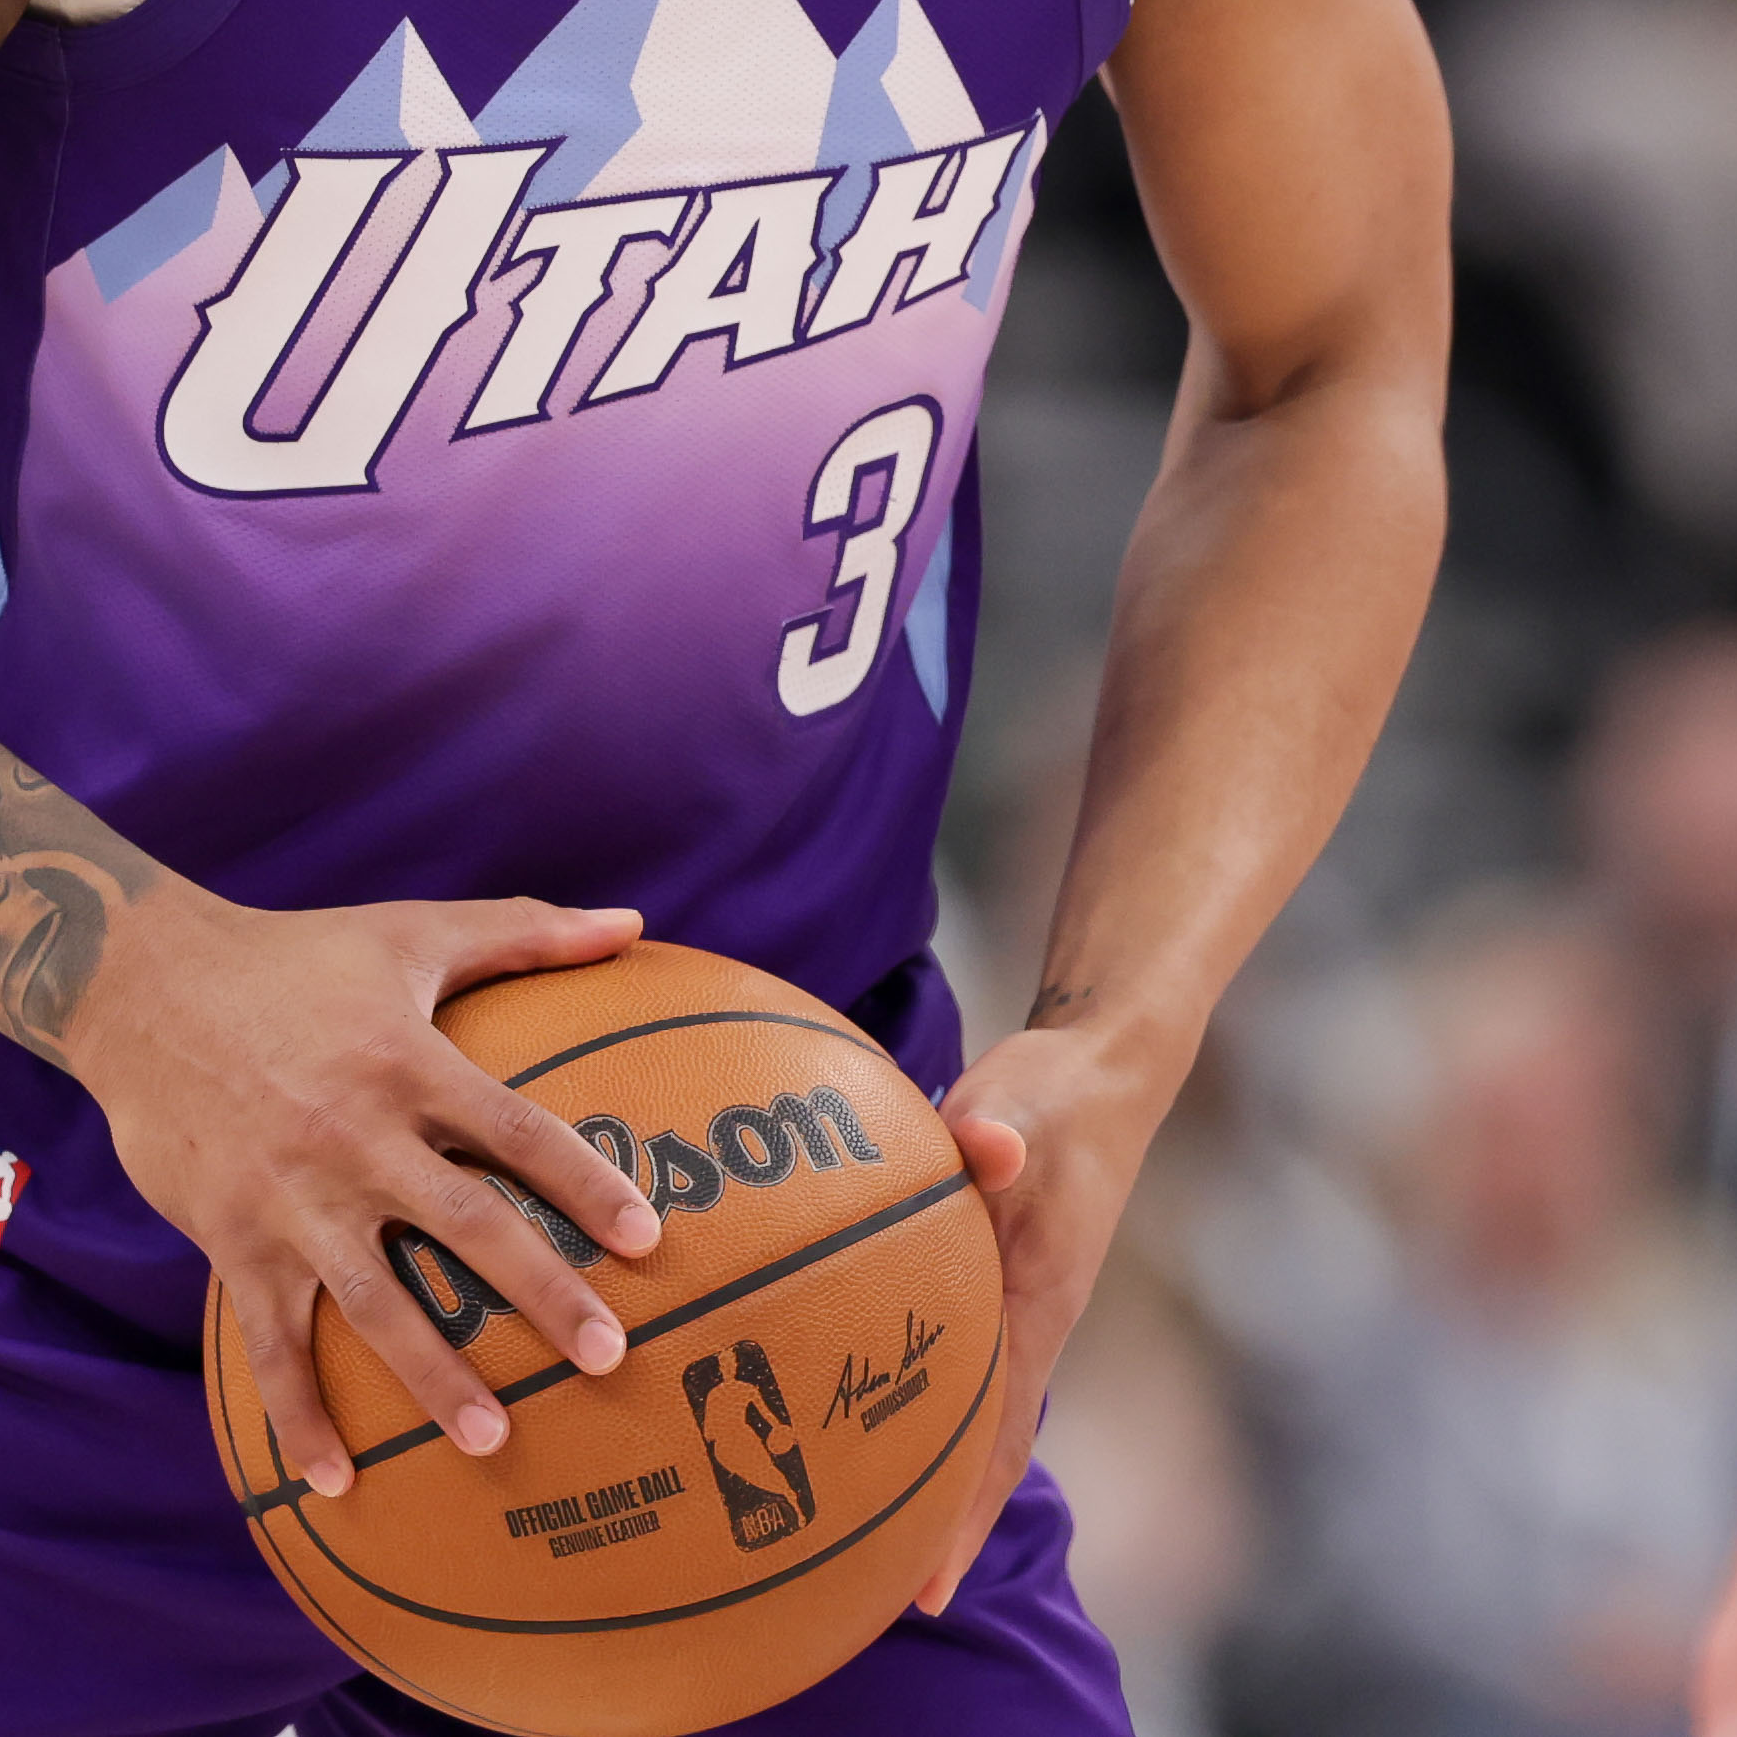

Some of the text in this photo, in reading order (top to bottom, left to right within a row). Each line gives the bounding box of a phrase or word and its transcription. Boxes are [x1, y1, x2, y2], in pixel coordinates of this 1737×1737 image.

[773, 393, 945, 720] 3
[860, 1367, 931, 1433] COMMISSIONER
[504, 1465, 686, 1538] OFFICIAL GAME BALL
[548, 1510, 661, 1558] GENUINE LEATHER
[741, 1502, 785, 1542] NBA
